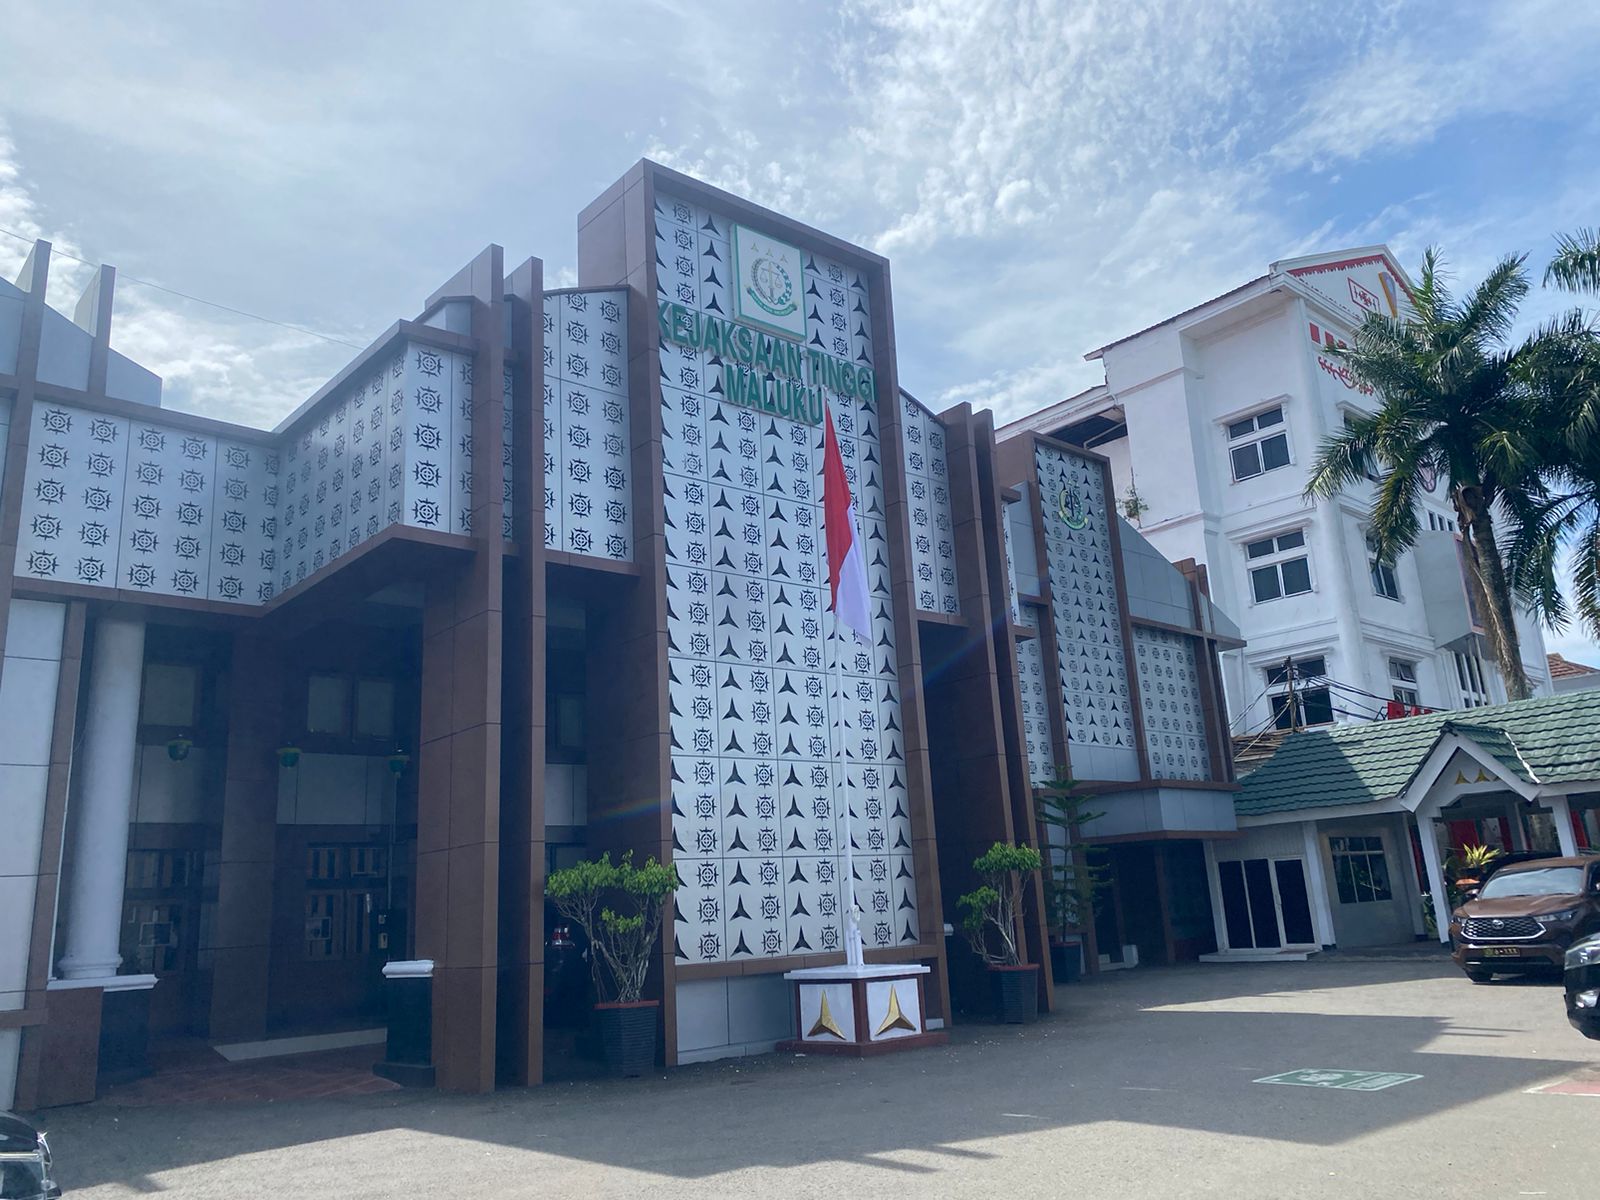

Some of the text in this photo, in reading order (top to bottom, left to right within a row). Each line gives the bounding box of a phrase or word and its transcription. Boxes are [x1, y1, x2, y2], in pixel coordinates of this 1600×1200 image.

[658, 302, 878, 403] KEJAKSAAN TINGGI
[724, 365, 823, 425] MALUKU
